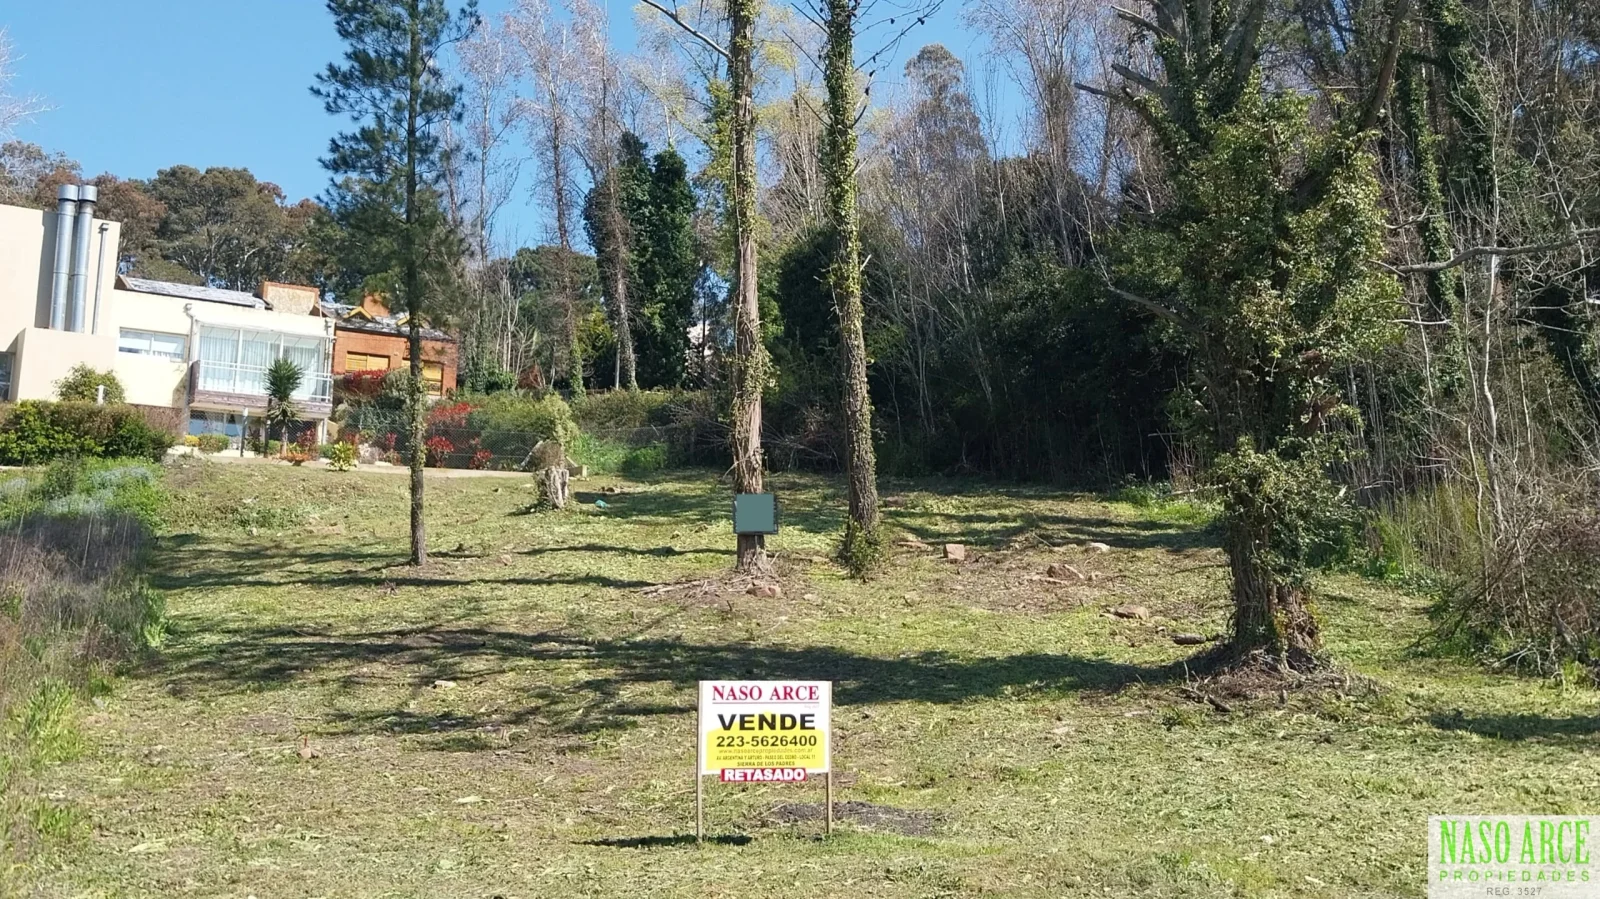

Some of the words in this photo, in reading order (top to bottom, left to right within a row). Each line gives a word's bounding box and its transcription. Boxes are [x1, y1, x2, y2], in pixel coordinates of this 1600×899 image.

[712, 686, 762, 700] NASO
[769, 686, 819, 700] ARCE
[717, 714, 815, 731] VENDE
[716, 735, 817, 747] 223-5626400
[724, 768, 805, 781] RETASADO
